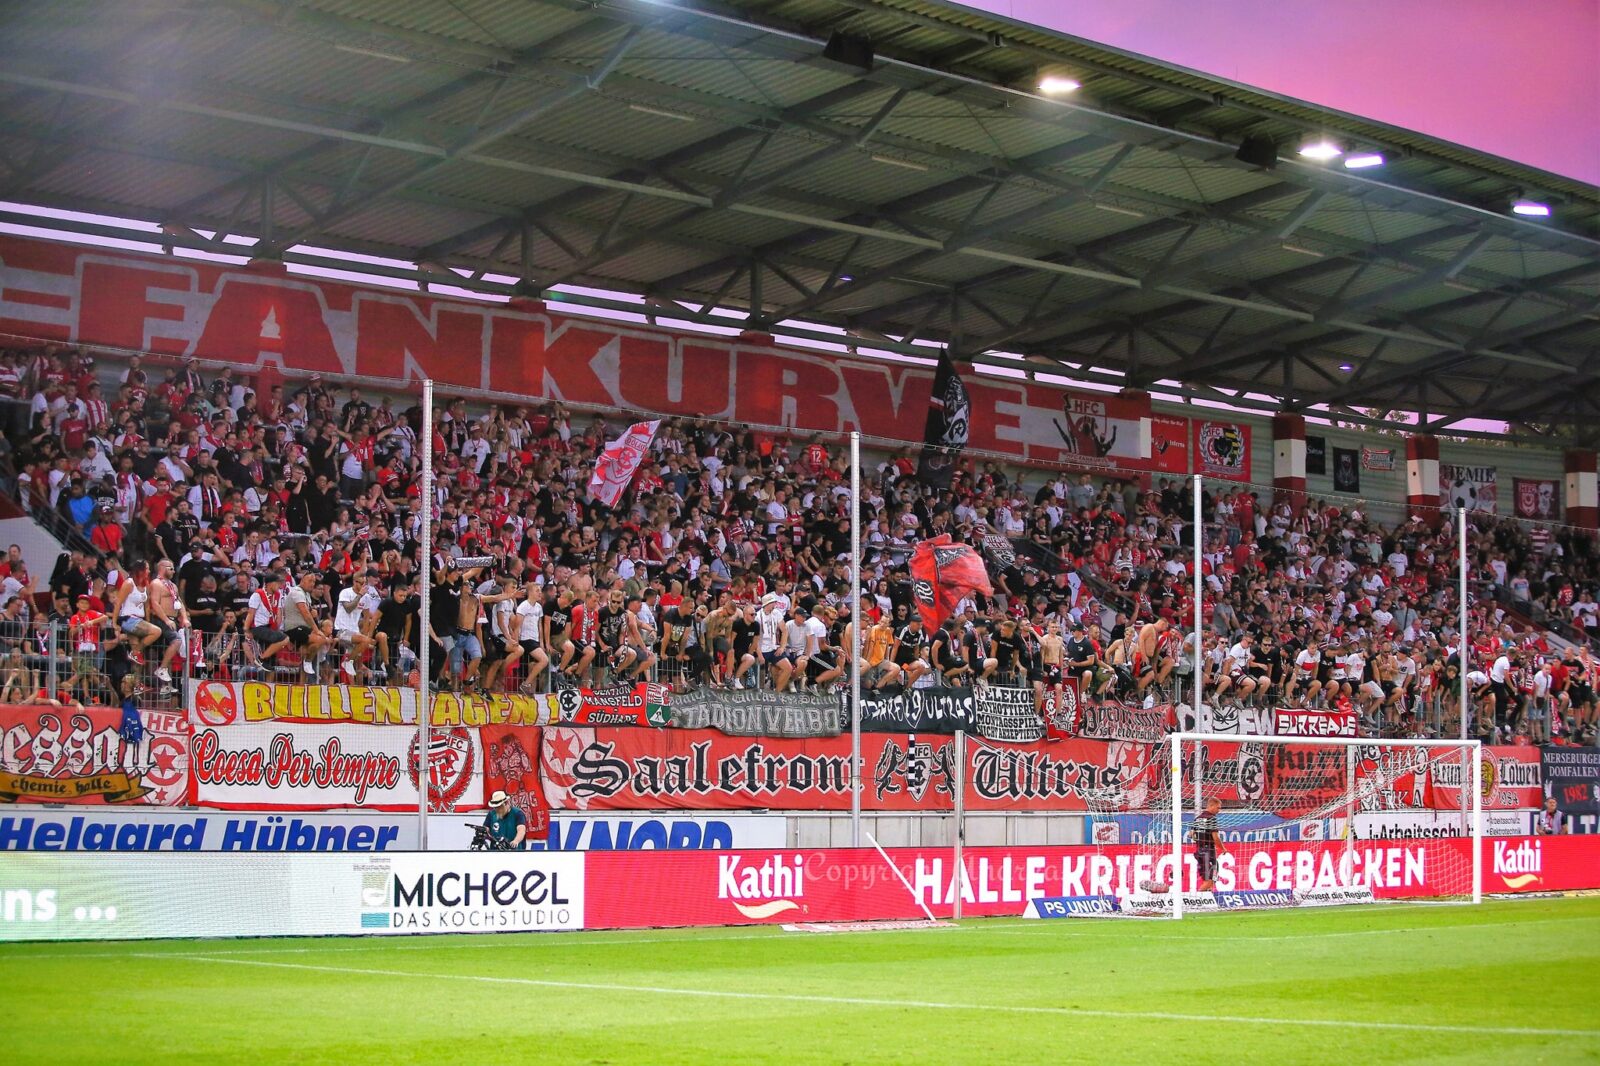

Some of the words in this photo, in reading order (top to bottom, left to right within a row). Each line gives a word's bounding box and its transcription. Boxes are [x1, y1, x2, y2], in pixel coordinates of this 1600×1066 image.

[72, 253, 1034, 462] FANKURVE
[242, 682, 402, 726] BULLEN
[583, 695, 643, 707] MANSFELD
[147, 713, 189, 733] HFC
[0, 714, 155, 779] essau
[1544, 753, 1600, 764] MERSEBURGE
[315, 737, 400, 803] Sempre
[1549, 766, 1599, 777] DOMFALKEN
[1563, 783, 1588, 804] 1982
[223, 816, 398, 850] Hübner
[1494, 840, 1541, 873] Kathi
[718, 855, 803, 899] Kathi
[914, 855, 1046, 905] HALLE
[1249, 848, 1425, 893] GEBACKEN
[0, 889, 57, 921] ns
[1044, 901, 1067, 914] PS
[1069, 898, 1112, 914] UNION
[1184, 896, 1215, 908] Region
[1224, 895, 1244, 908] PS
[1246, 890, 1289, 907] UNION
[393, 912, 431, 928] DAS
[439, 909, 570, 927] KOCHSTUDIO
